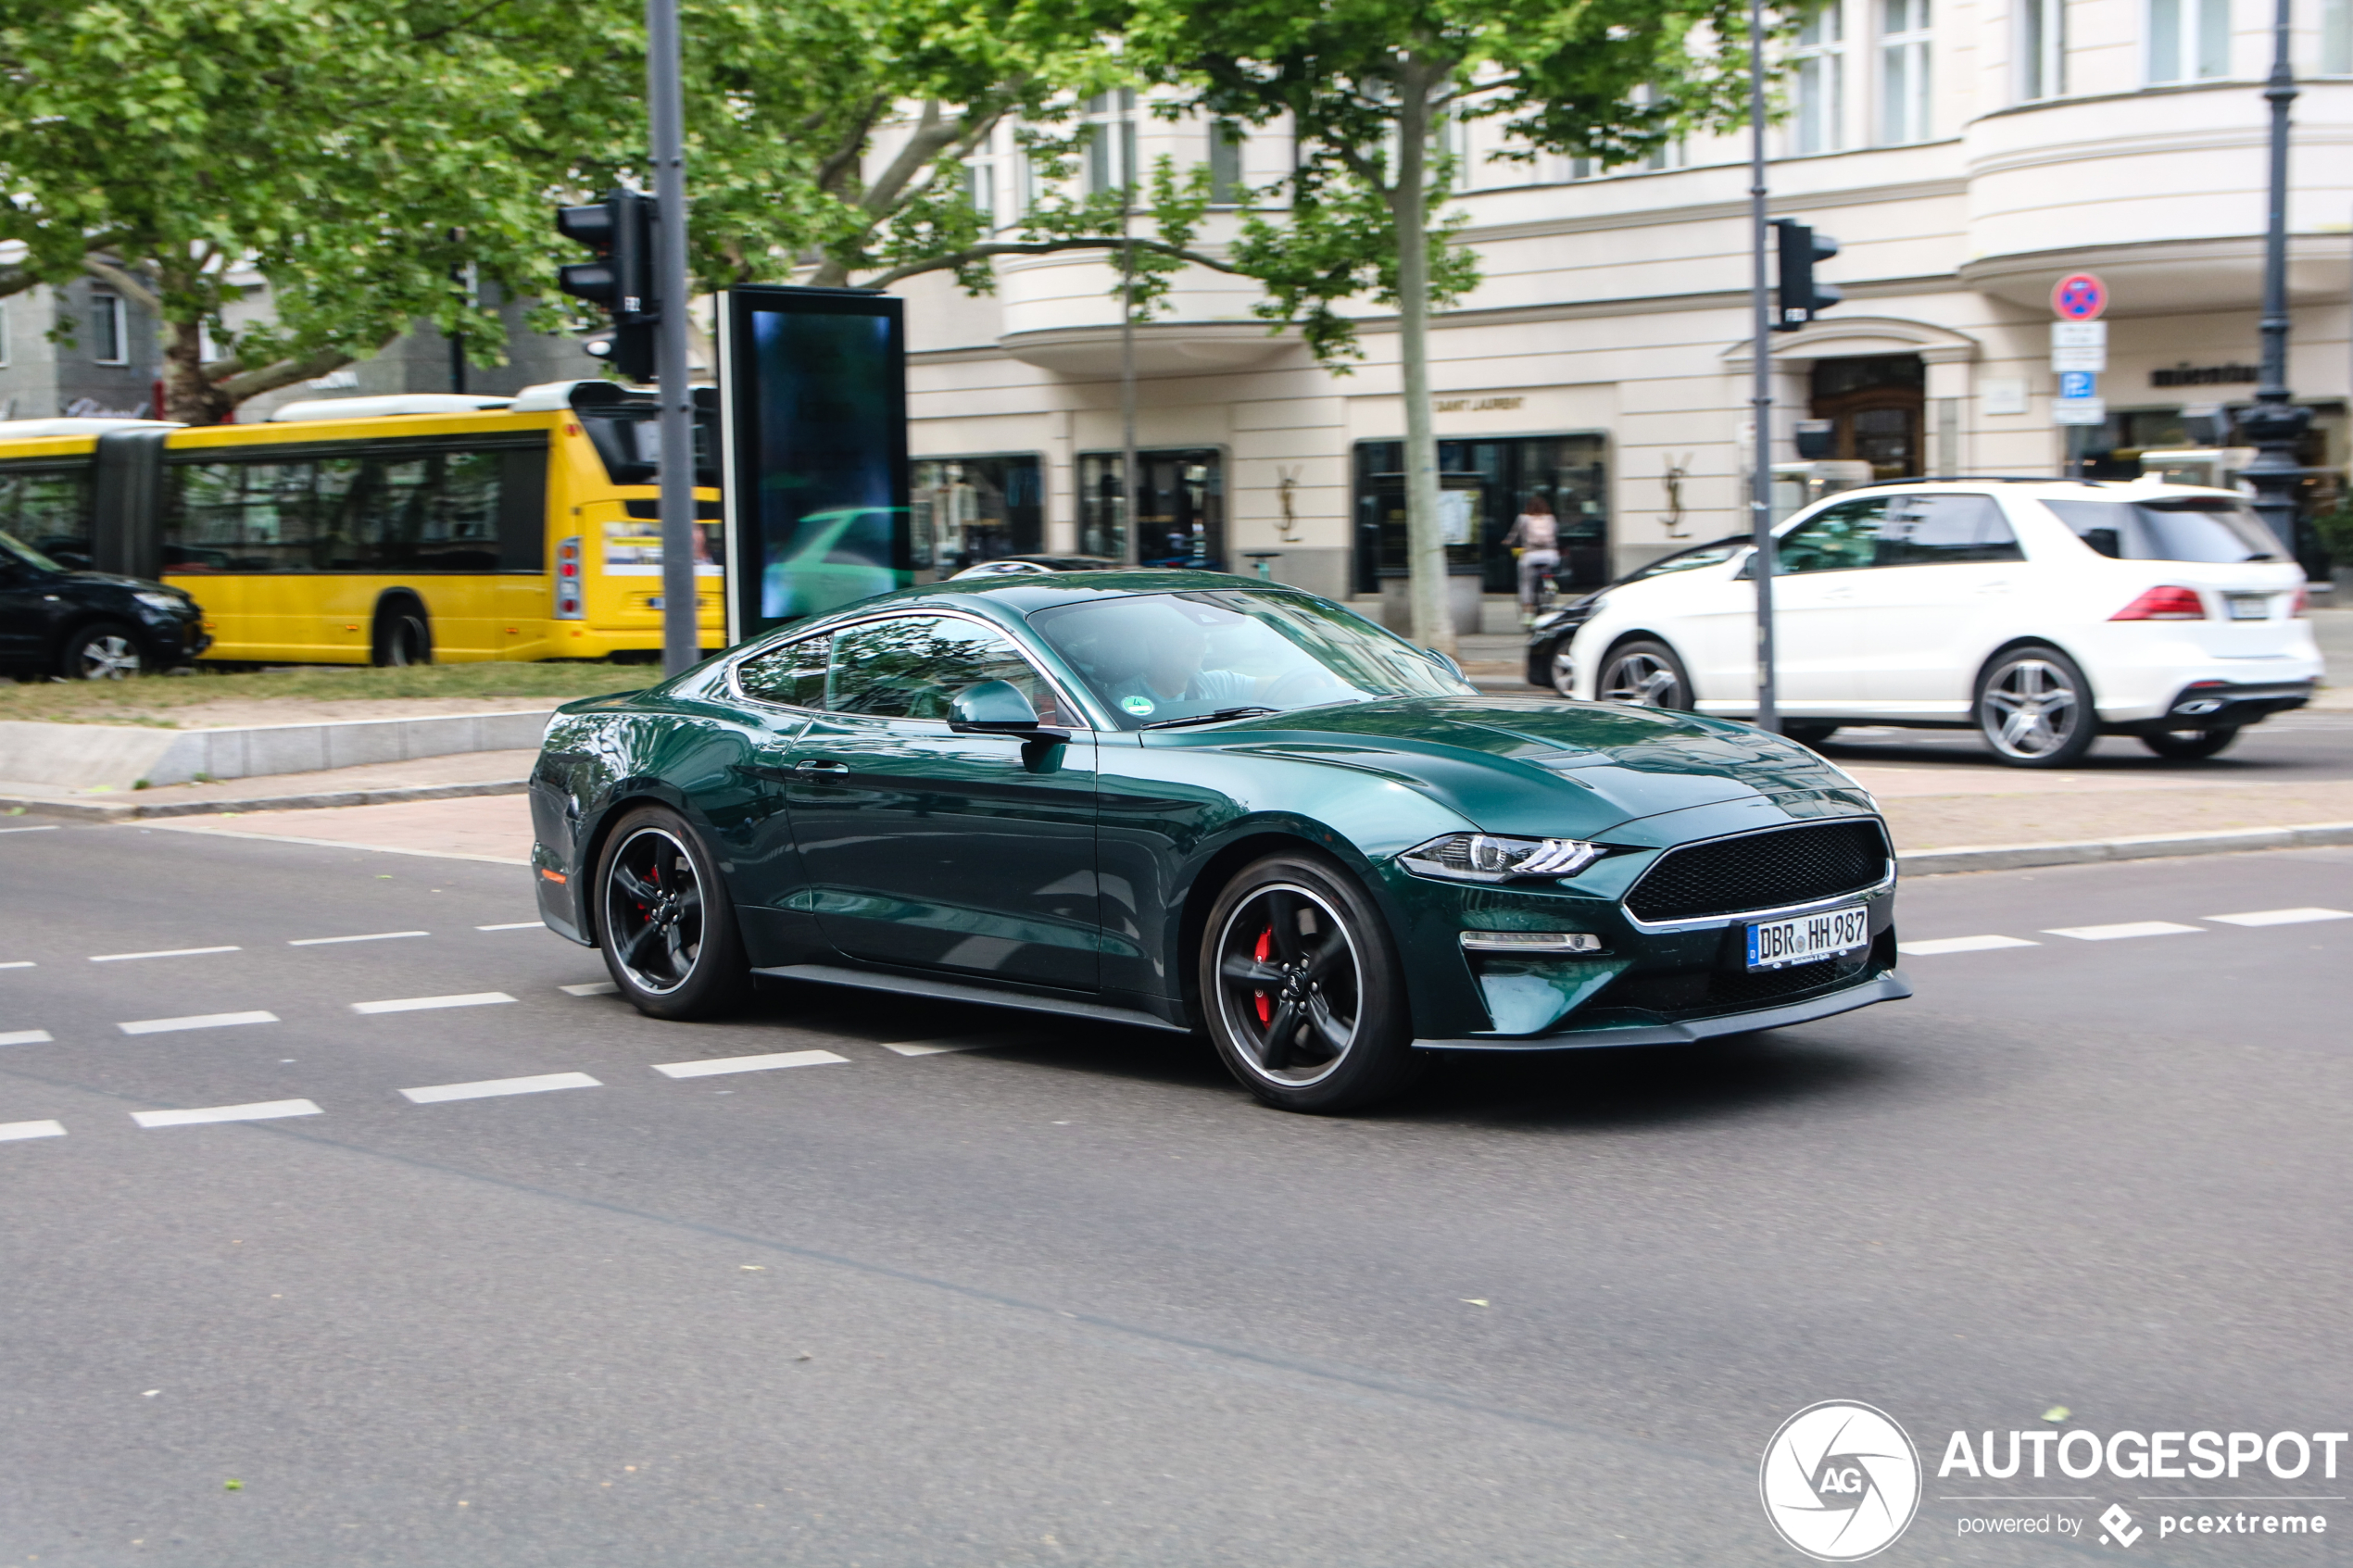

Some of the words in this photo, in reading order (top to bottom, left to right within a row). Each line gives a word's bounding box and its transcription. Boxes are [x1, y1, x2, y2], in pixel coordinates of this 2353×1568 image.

[1133, 698, 1141, 707] 4
[1760, 923, 1794, 960] DBR
[1808, 917, 1831, 950] HH
[1835, 910, 1865, 945] 987
